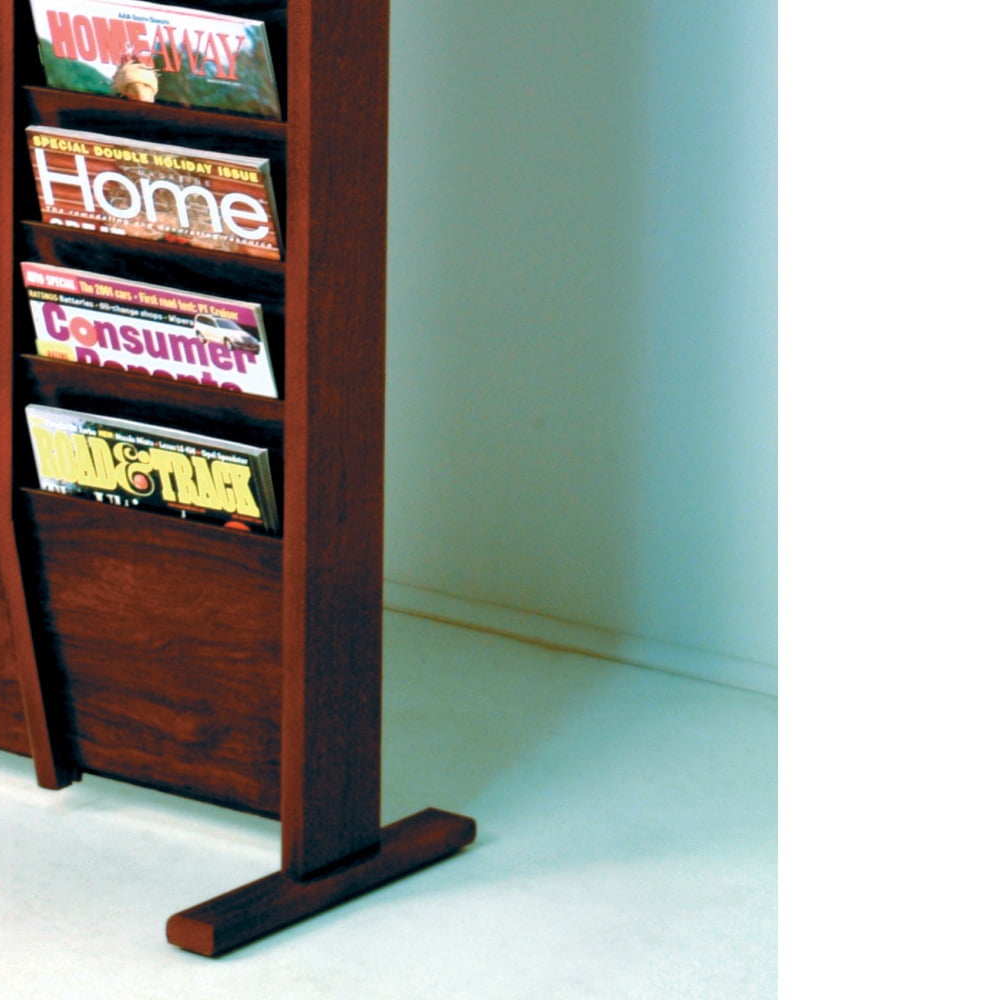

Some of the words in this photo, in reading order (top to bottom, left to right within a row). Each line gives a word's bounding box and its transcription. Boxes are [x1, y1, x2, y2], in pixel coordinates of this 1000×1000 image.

[32, 135, 90, 155] SPECIAL
[93, 145, 149, 164] DOUBLE
[153, 154, 213, 175] HOLIDAY
[217, 167, 260, 183] ISSUE
[34, 147, 270, 241] Home
[45, 275, 78, 291] SPECIAL
[79, 280, 94, 294] The
[114, 289, 133, 301] cars
[138, 291, 159, 306] First
[59, 294, 94, 308] Batteries
[42, 301, 258, 374] Consumer
[31, 425, 118, 491] ROAD
[112, 442, 155, 497] &
[150, 447, 261, 519] TRACK
